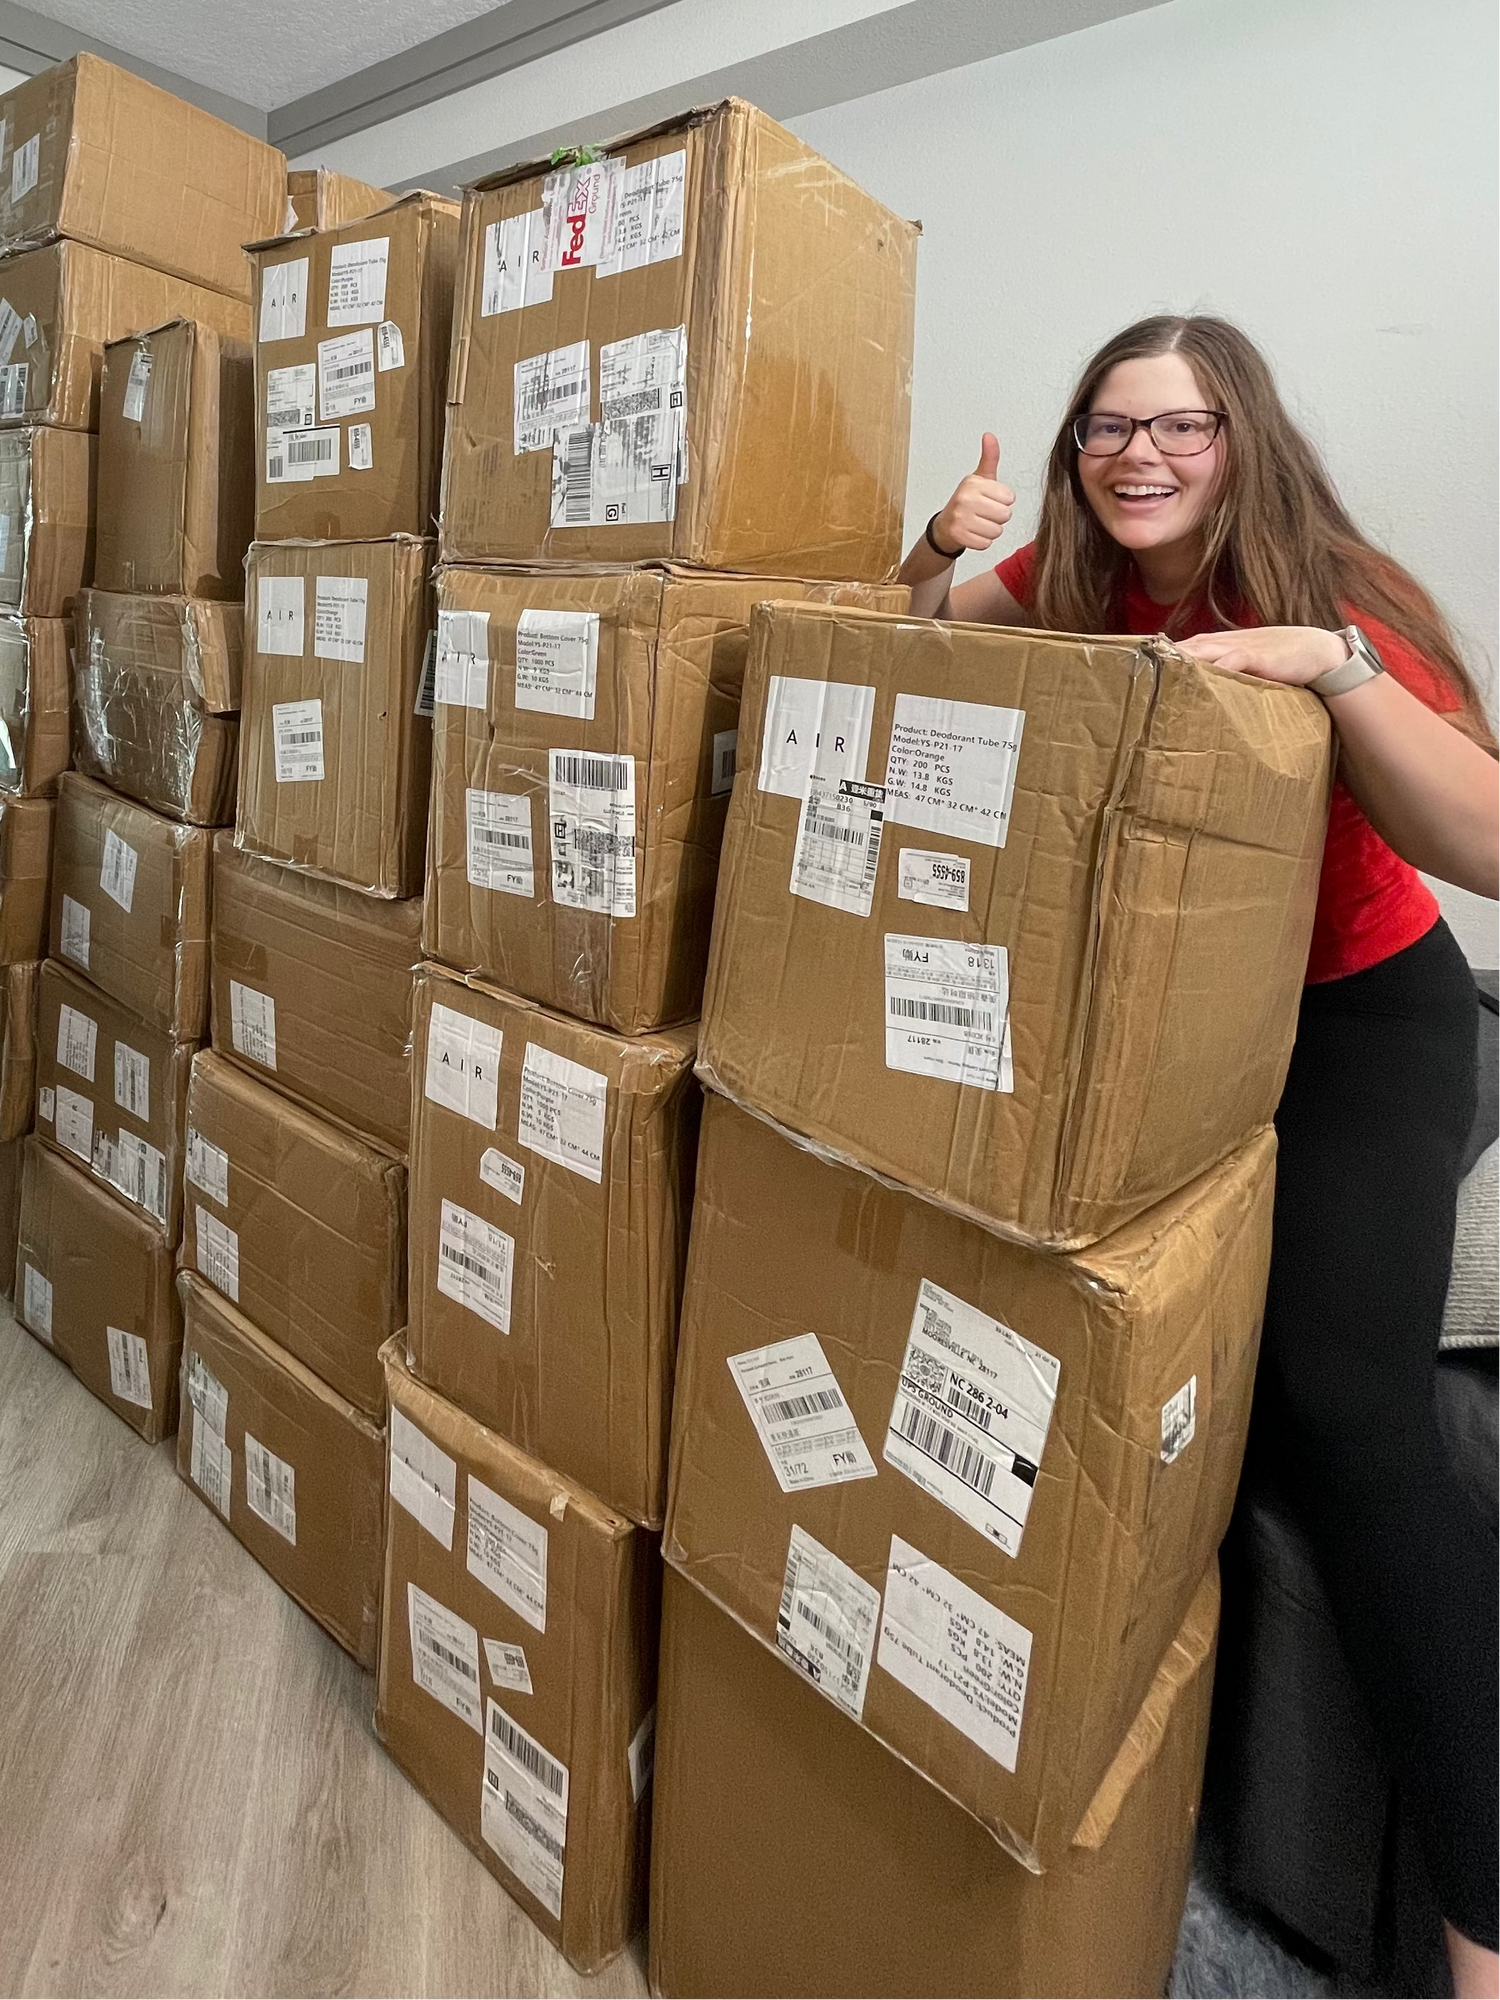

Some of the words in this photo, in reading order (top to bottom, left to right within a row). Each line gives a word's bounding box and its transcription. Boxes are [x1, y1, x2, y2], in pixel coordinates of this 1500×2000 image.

[671, 173, 682, 184] 75g
[588, 173, 601, 214] Ground
[561, 176, 591, 266] FedEx
[629, 214, 639, 223] PCS
[630, 222, 642, 231] KGS
[630, 231, 641, 240] KGS
[669, 228, 679, 236] CM
[652, 466, 669, 479] H
[539, 632, 559, 640] Bottom
[894, 723, 928, 735] Product:
[929, 729, 975, 743] Deodorant
[977, 736, 1000, 747] Tube
[1001, 740, 1018, 752] 75g
[891, 744, 945, 763] Color:Orange
[890, 755, 909, 765] QTY:
[912, 759, 928, 769] 200
[934, 763, 950, 774] PCS
[888, 766, 908, 776] N.W:
[912, 770, 930, 781] 13.8
[936, 775, 953, 785] KGS
[887, 777, 906, 787] G.W:
[910, 781, 927, 792] 14.8
[934, 786, 951, 797] KGS
[886, 787, 911, 799] MEAS:
[914, 793, 925, 802] 47
[947, 800, 957, 809] 32
[980, 808, 991, 816] 42
[932, 864, 966, 884] 859-4555
[907, 1034, 930, 1045] 28117
[581, 1147, 588, 1156] 44
[589, 1151, 600, 1162] CM
[921, 1325, 964, 1359] MOORESVILLE
[966, 1354, 976, 1366] NC
[977, 1362, 997, 1381] 28117
[794, 1366, 814, 1378] 28117
[900, 1375, 917, 1394] UPS
[917, 1387, 954, 1419] GROUND
[949, 1371, 965, 1391] NC
[965, 1382, 986, 1404] 286
[985, 1395, 1009, 1421] 2-04
[891, 1561, 906, 1579] CM
[908, 1573, 919, 1588] 42
[942, 1598, 953, 1612] 32
[883, 1624, 899, 1646] 75g
[948, 1615, 967, 1636] KGS
[977, 1625, 989, 1641] 47
[946, 1626, 966, 1648] KGS
[901, 1640, 923, 1664] Tube
[949, 1641, 968, 1662] PCS
[973, 1646, 992, 1668] 13.8
[994, 1637, 1025, 1667] MEAS:
[925, 1659, 973, 1705] Deodorant
[974, 1661, 992, 1682] 200
[997, 1665, 1022, 1691] N.W:
[961, 1663, 1019, 1715] Color:Green
[996, 1677, 1021, 1703] QTY:
[975, 1699, 1016, 1738] Product:
